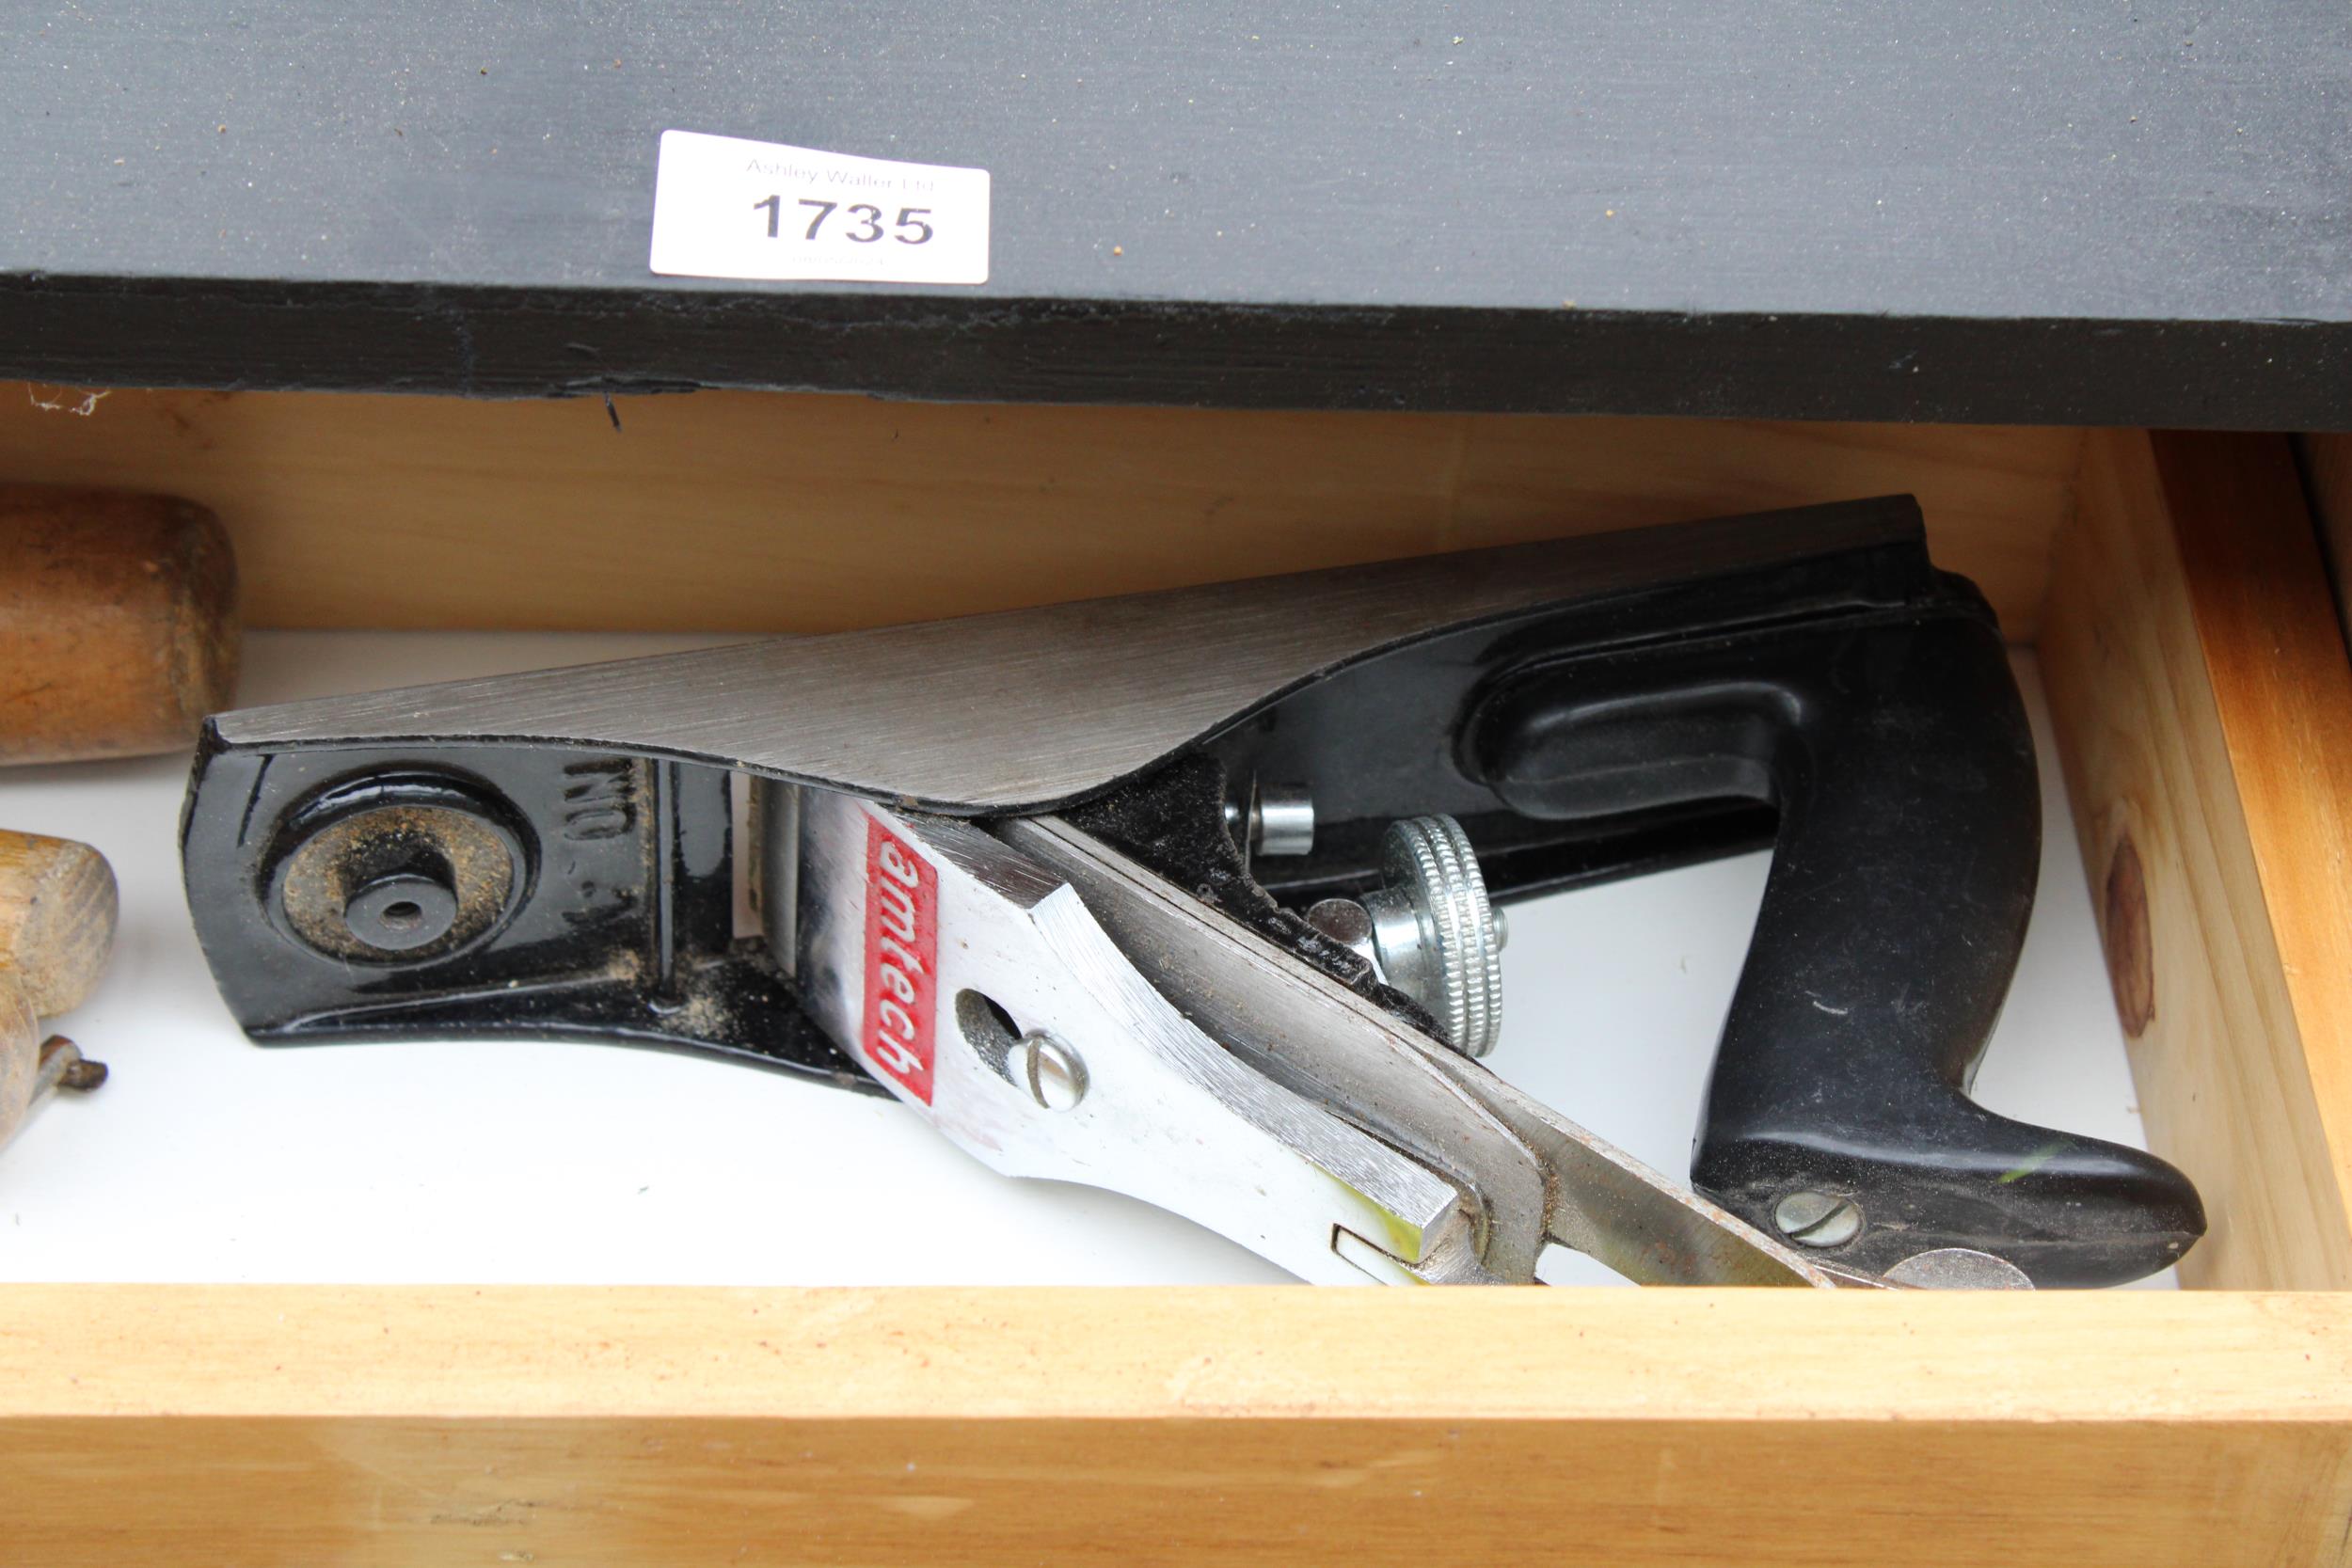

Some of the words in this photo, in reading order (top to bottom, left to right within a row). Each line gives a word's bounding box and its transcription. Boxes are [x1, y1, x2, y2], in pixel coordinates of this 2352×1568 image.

[745, 158, 819, 184] Ashley
[826, 169, 893, 190] Waller
[753, 194, 934, 245] 1735
[876, 840, 925, 1075] amtech
